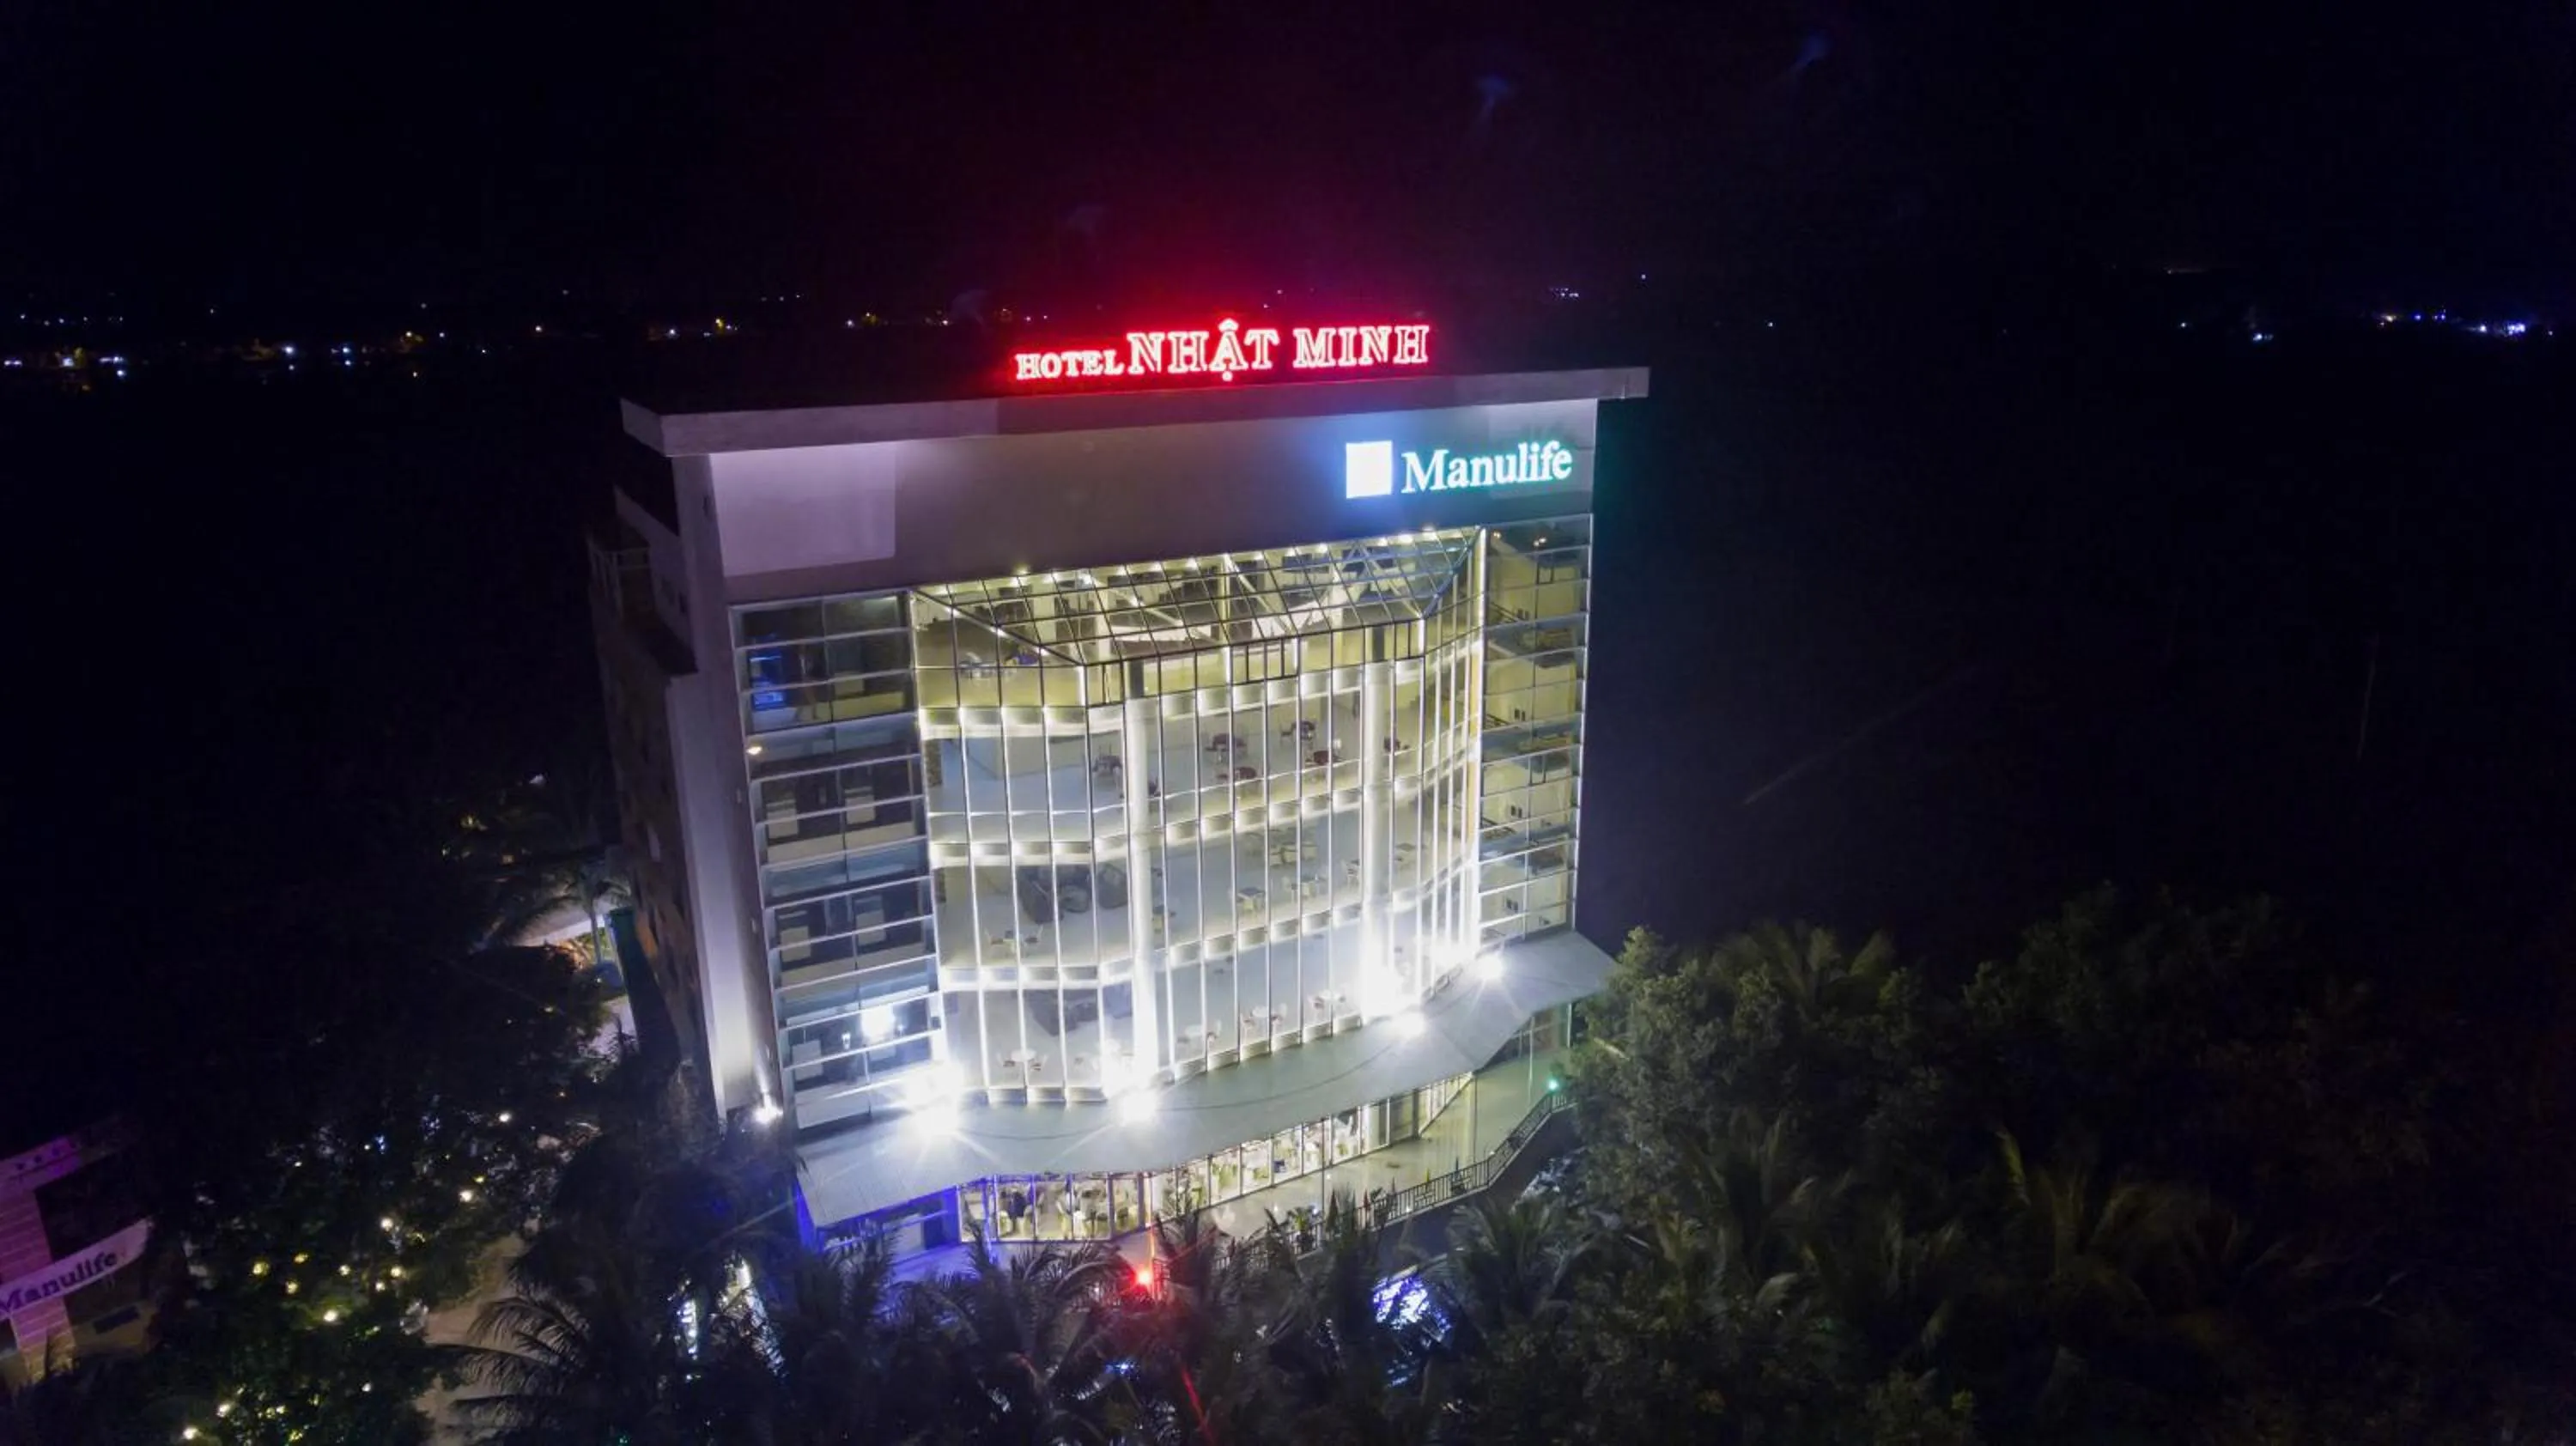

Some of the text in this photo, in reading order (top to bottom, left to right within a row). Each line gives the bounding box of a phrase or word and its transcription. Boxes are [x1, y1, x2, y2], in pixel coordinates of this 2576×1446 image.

[1017, 319, 1429, 381] HOTEL NHẬT MINH
[1400, 440, 1573, 494] Manulife
